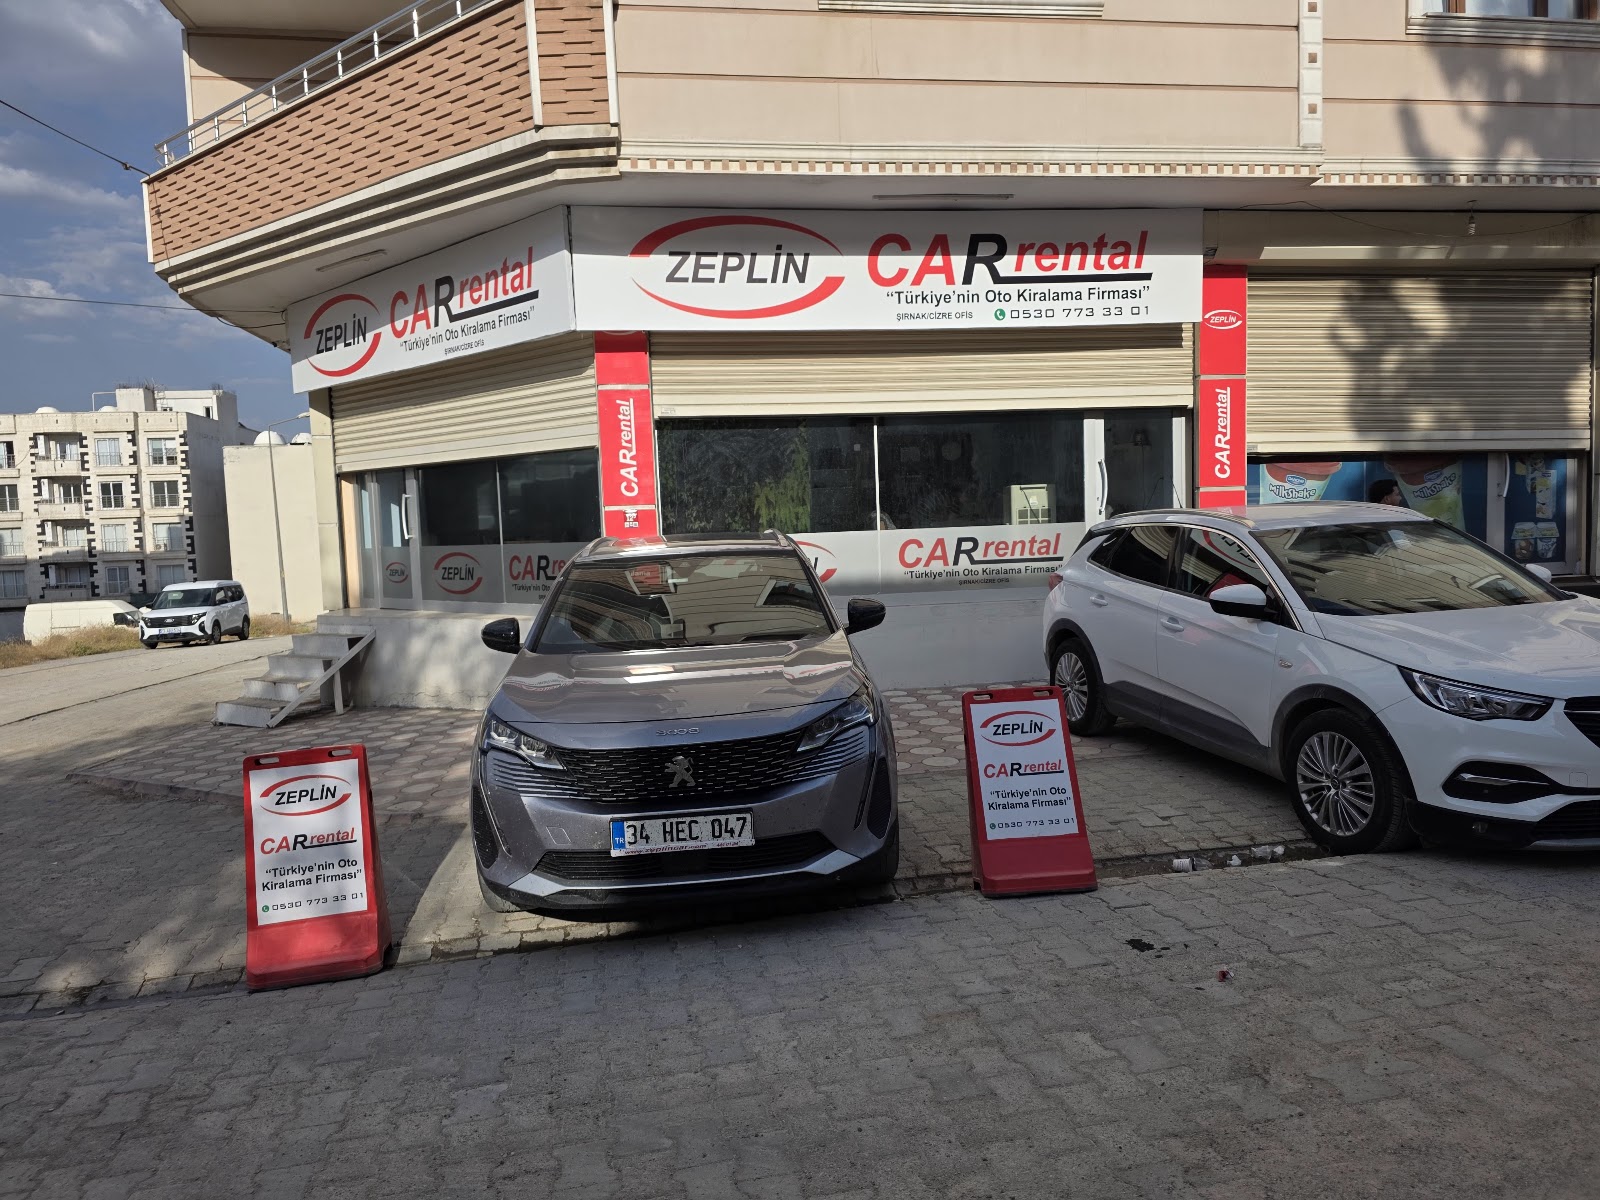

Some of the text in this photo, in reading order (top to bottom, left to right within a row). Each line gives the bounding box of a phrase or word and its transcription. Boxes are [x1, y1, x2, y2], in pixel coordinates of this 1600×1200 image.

[666, 244, 810, 284] ZEPLİN
[985, 290, 1012, 303] Oto
[1017, 288, 1082, 302] Kiralama
[955, 310, 973, 319] OFİS
[1010, 306, 1150, 318] 0530 773 33 01
[1210, 314, 1236, 323] ZEPLİN
[316, 314, 367, 354] ZEPLİN
[445, 329, 458, 341] Oto
[461, 321, 496, 336] Kiralama
[442, 564, 474, 581] ZEPLİN
[962, 568, 979, 577] Oto
[982, 566, 1022, 576] Kiralama
[993, 720, 1042, 736] ZEPLİN
[275, 784, 337, 806] ZEPLİN
[1050, 787, 1066, 795] Oto
[988, 801, 1029, 810] Kiralama
[626, 817, 747, 845] 34 HEC 047
[338, 858, 358, 868] Oto
[262, 876, 312, 892] Kiralama
[272, 892, 364, 911] 0530 773 33 01
